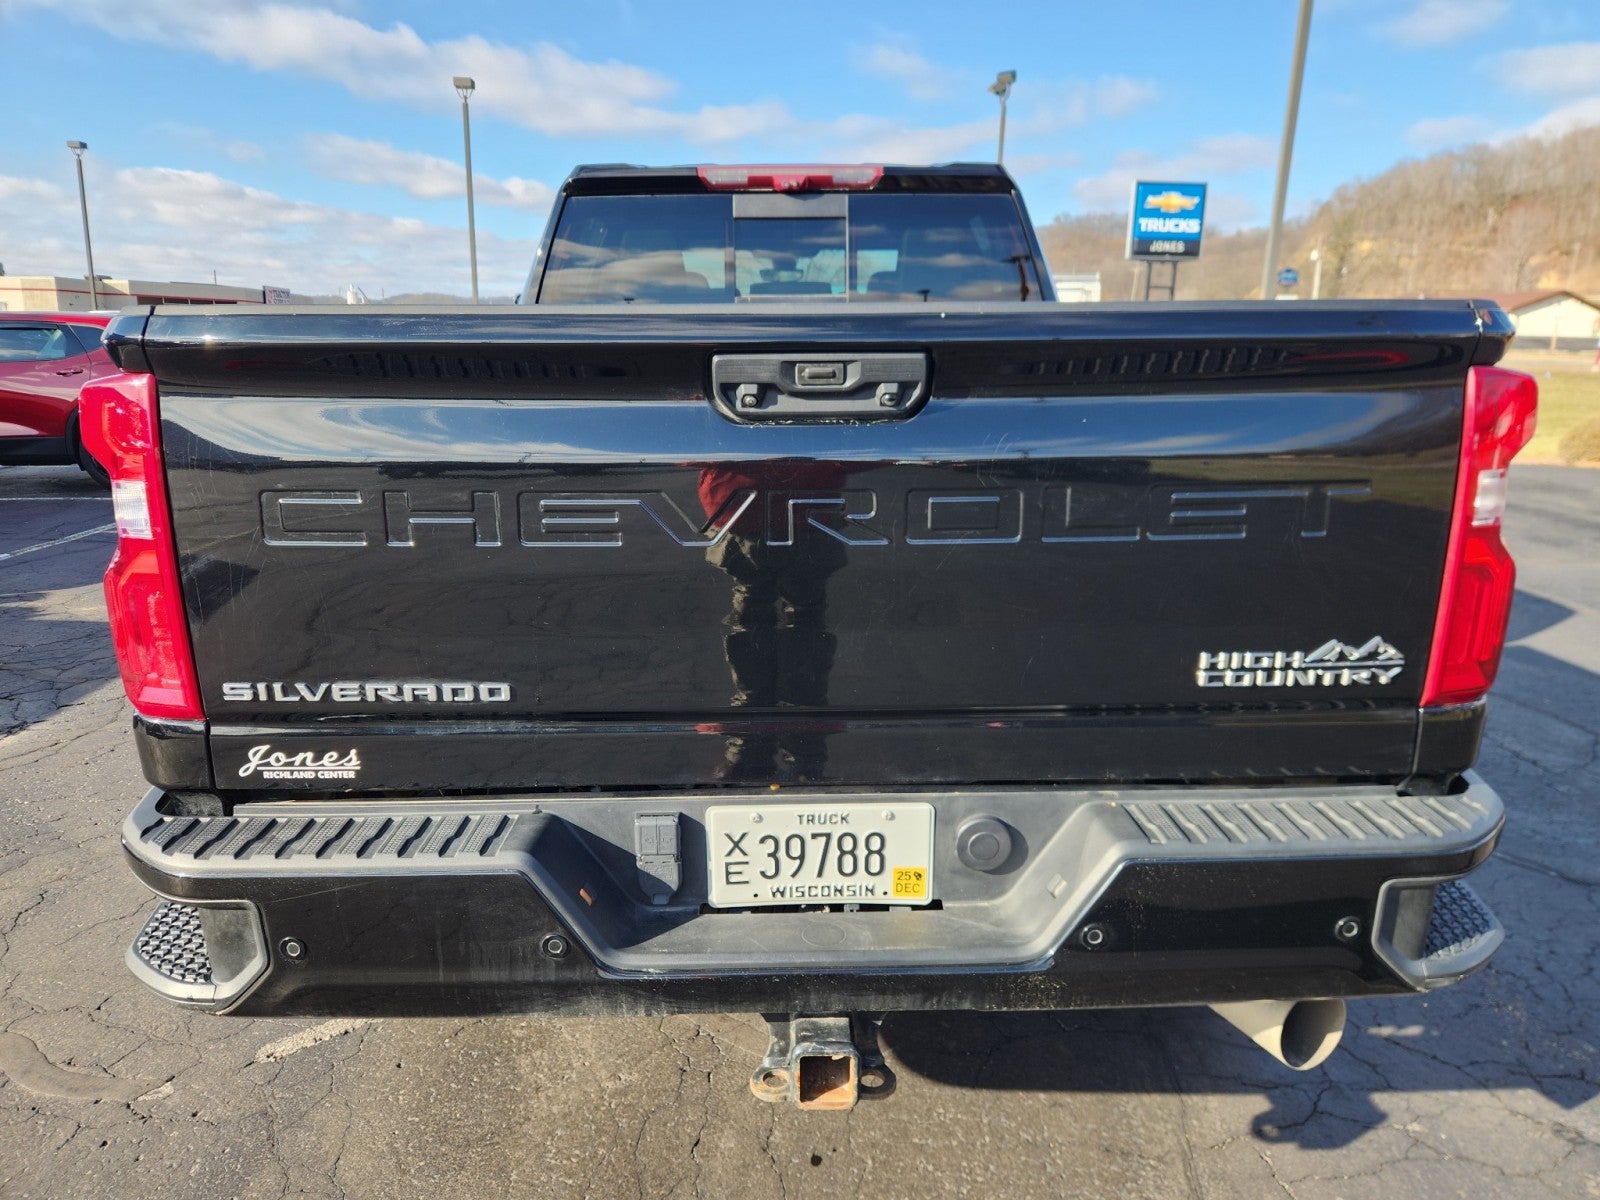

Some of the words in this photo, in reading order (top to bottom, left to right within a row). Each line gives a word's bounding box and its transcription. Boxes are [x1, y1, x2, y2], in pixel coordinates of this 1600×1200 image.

[1138, 217, 1201, 233] TRUCKS
[1149, 239, 1186, 253] JONES
[258, 479, 1372, 548] CHEVROLET
[1197, 651, 1305, 670] HIGH
[1196, 667, 1403, 687] COUNTRY
[222, 681, 511, 703] SILVERADO
[238, 744, 361, 778] Jones
[262, 771, 315, 779] RICHLAND
[317, 771, 356, 779] CENTER
[797, 812, 850, 826] TRUCK
[758, 831, 887, 880] 39788
[896, 871, 912, 882] 25
[769, 884, 876, 899] WISCONSIN
[895, 882, 921, 894] DEC
